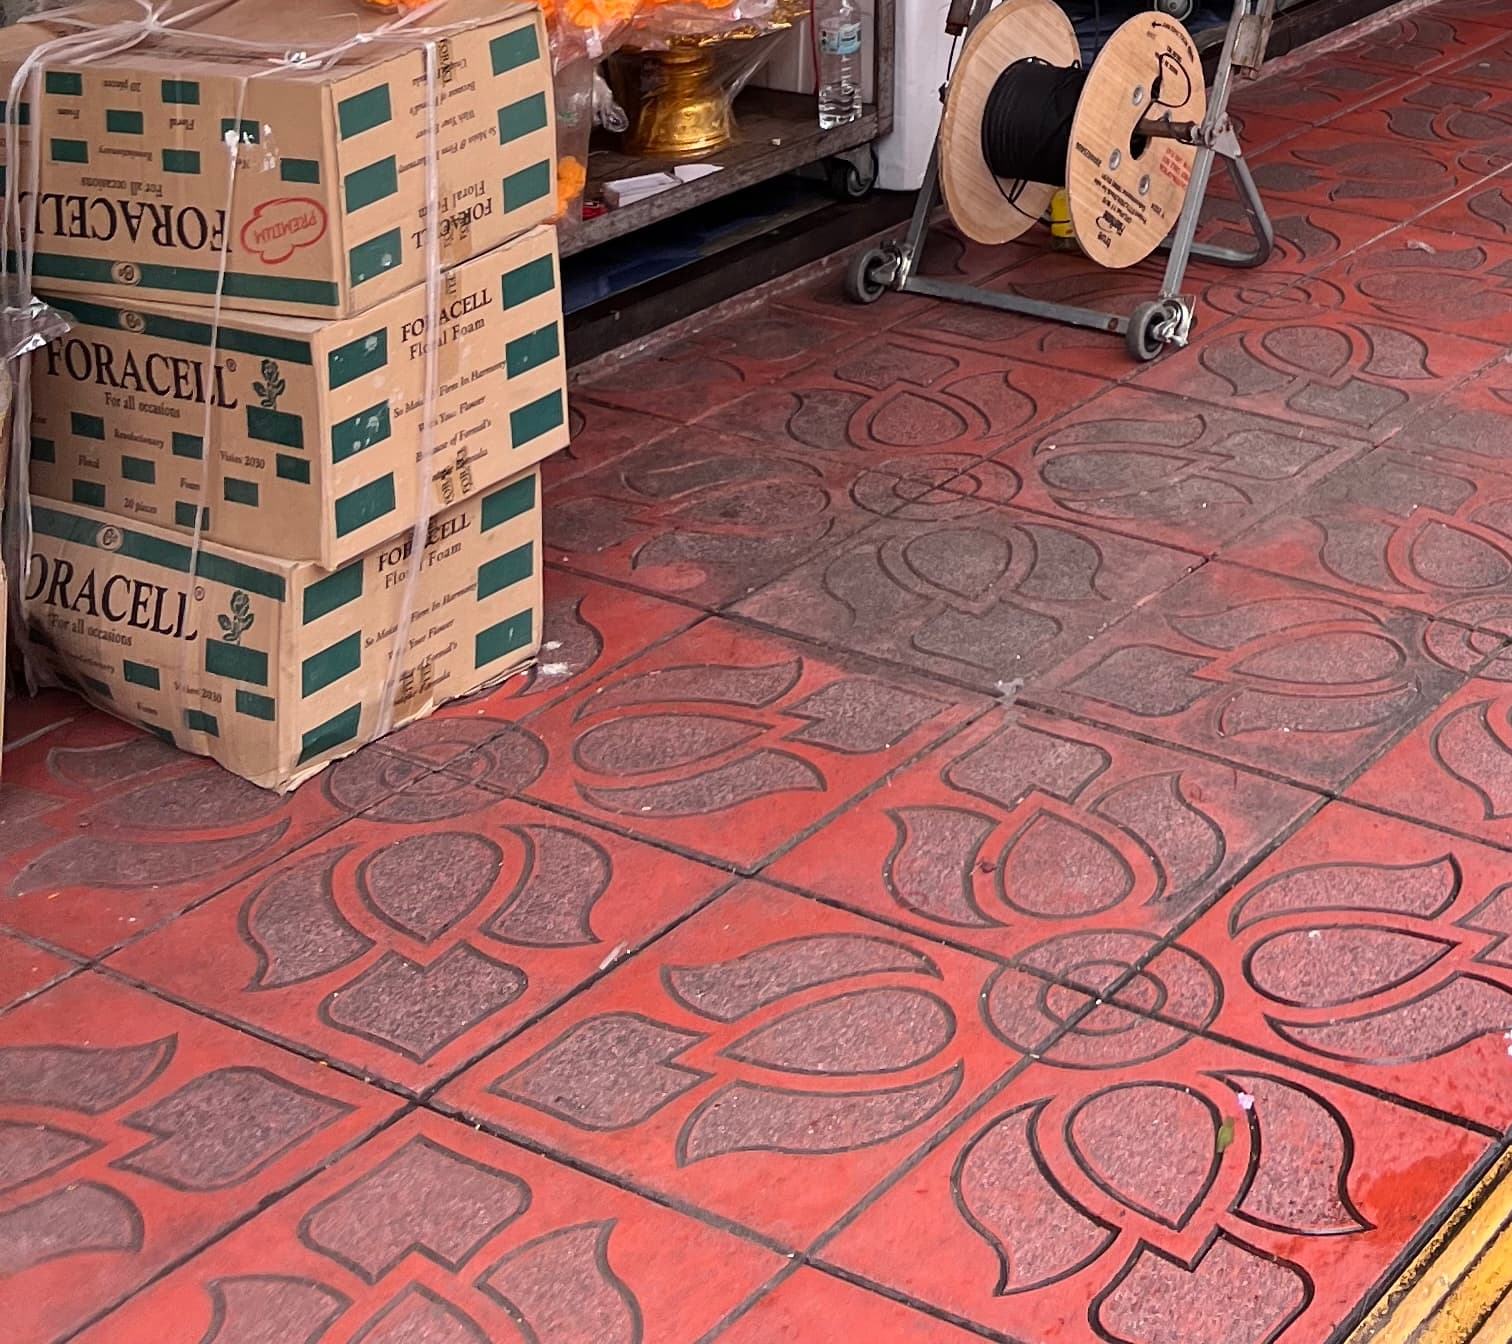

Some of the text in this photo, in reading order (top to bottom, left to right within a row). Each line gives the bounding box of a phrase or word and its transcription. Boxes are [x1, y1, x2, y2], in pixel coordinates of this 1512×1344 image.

[81, 177, 162, 197] For all occasions
[451, 180, 486, 207] Floral
[254, 210, 319, 245] PREMIUM
[401, 288, 493, 343] FOACELL
[452, 317, 485, 341] Foam
[105, 392, 181, 419] For all occasions
[428, 542, 462, 567] Foam
[50, 615, 133, 646] For all occasions
